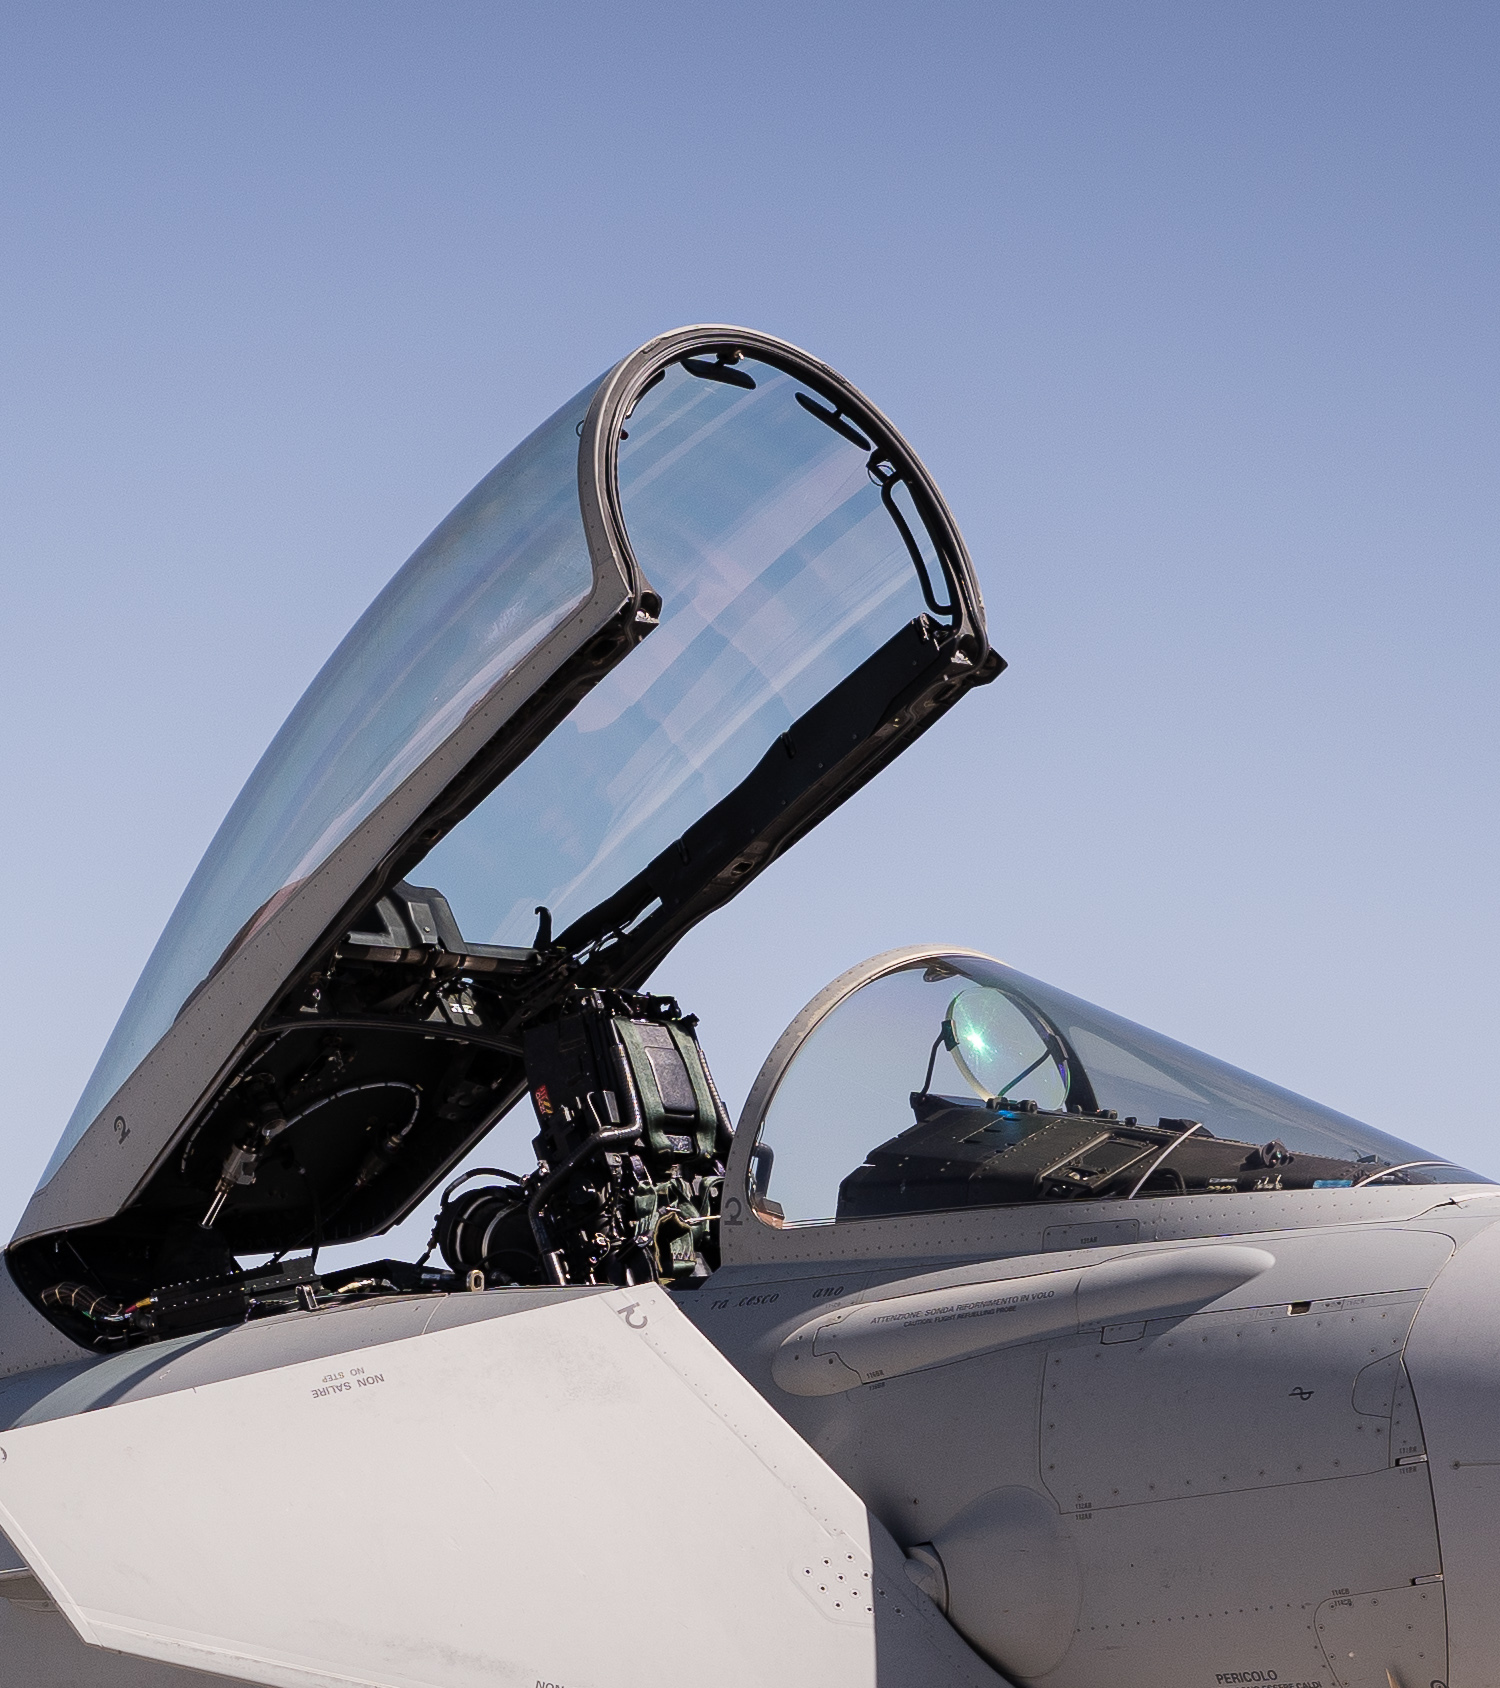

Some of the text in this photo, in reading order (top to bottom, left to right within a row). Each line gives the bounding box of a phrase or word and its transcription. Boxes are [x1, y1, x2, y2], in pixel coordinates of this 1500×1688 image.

[925, 1305, 954, 1316] SONDA
[955, 1296, 1019, 1311] RIFORNIMENTO
[1020, 1294, 1030, 1302] IN
[1031, 1290, 1055, 1300] VOLO
[934, 1315, 955, 1323] FLIGHT
[956, 1308, 995, 1320] REFUELLING
[996, 1305, 1017, 1315] PROBE
[322, 1367, 365, 1383] NO STEP
[311, 1374, 385, 1399] NON SALIRE
[1215, 1669, 1278, 1685] PERICOLO
